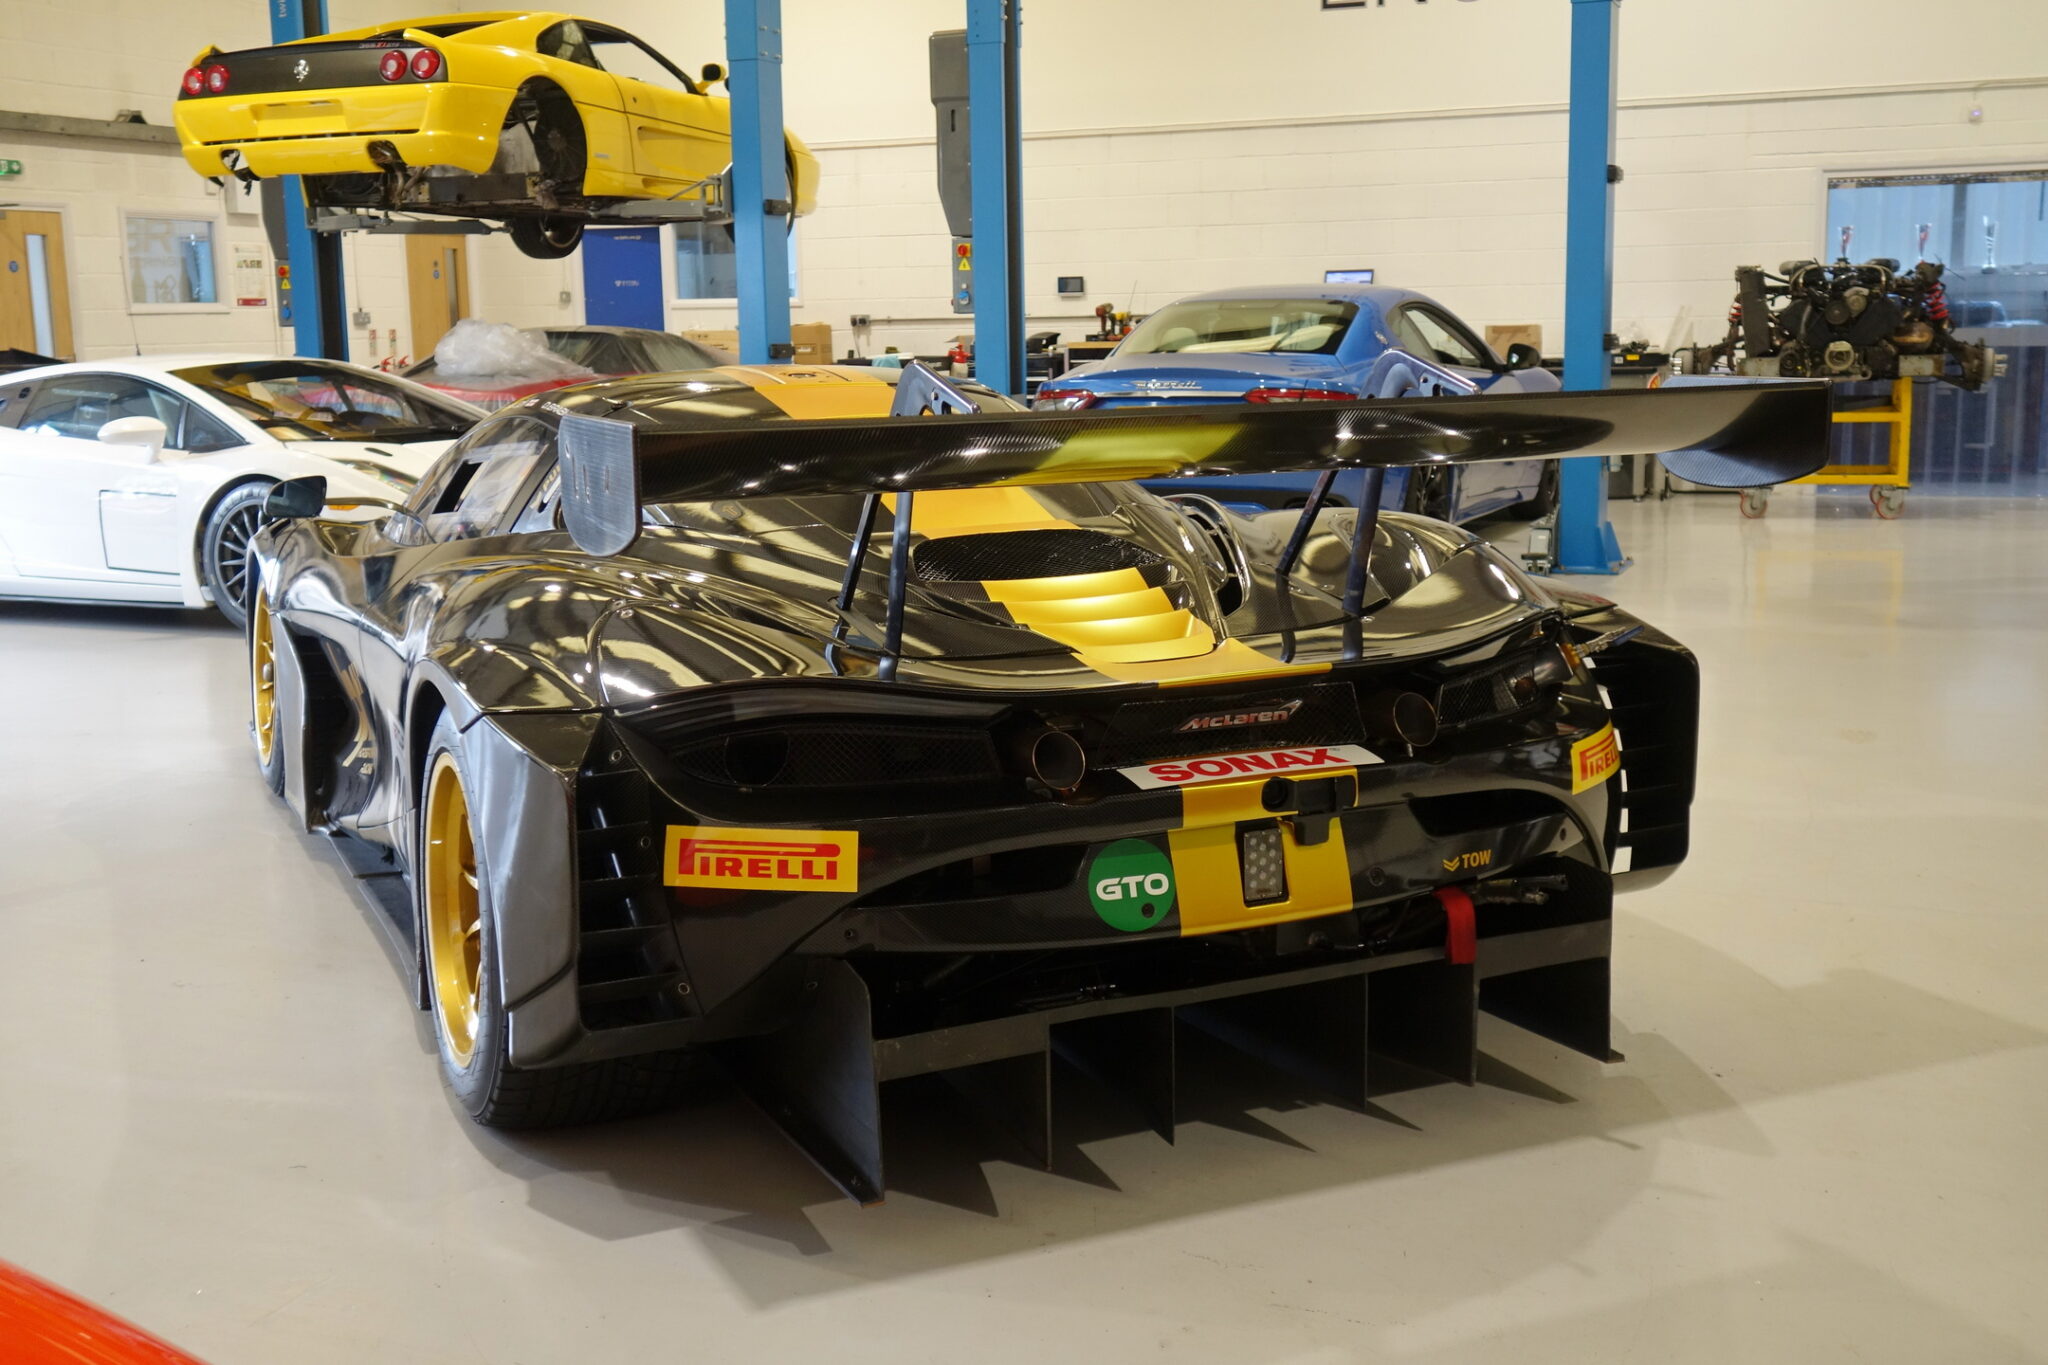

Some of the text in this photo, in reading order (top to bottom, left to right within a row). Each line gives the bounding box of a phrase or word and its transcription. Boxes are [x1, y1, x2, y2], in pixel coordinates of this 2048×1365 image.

[1179, 709, 1291, 732] McLaren
[1148, 747, 1350, 783] SONAX
[677, 837, 842, 881] PIRELLI
[1461, 848, 1492, 869] TOW
[1095, 872, 1170, 902] GTO
